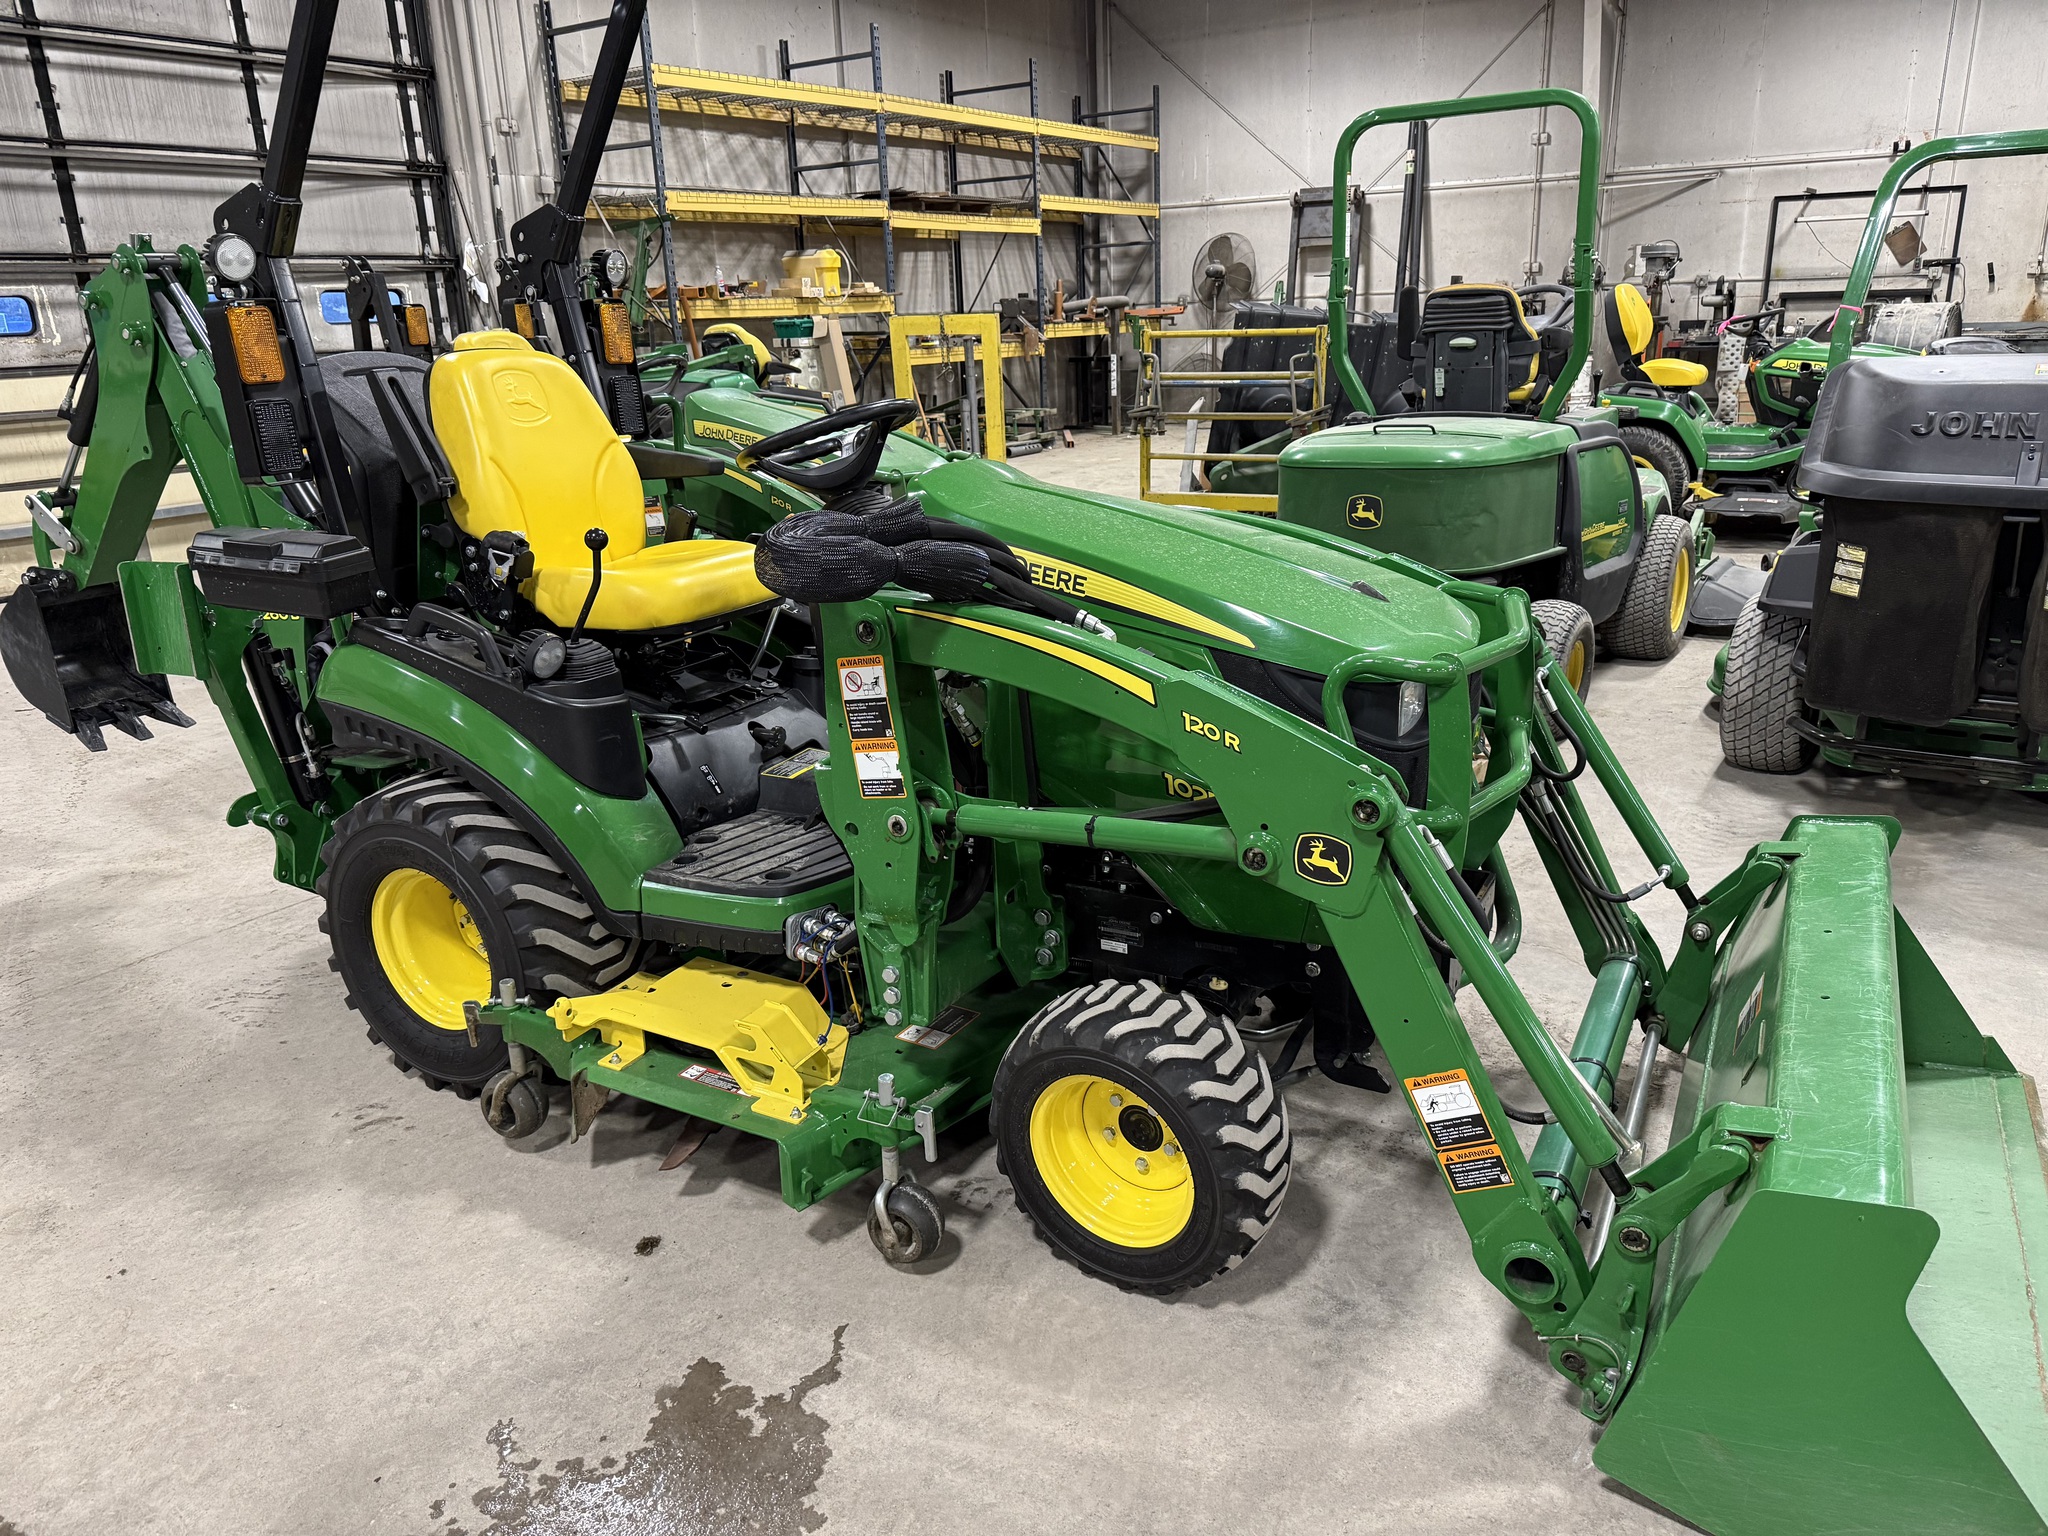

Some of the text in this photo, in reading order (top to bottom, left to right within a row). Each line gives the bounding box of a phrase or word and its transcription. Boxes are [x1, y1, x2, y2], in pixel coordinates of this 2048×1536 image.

[1910, 411, 2041, 439] JOHN
[700, 425, 759, 446] JOHN DEERE
[771, 496, 792, 512] 120 R
[846, 656, 881, 666] WARNING
[1181, 710, 1242, 754] 120 R
[860, 742, 895, 750] WARNING
[1421, 1073, 1461, 1085] WARNING
[1455, 1148, 1495, 1160] WARNING
